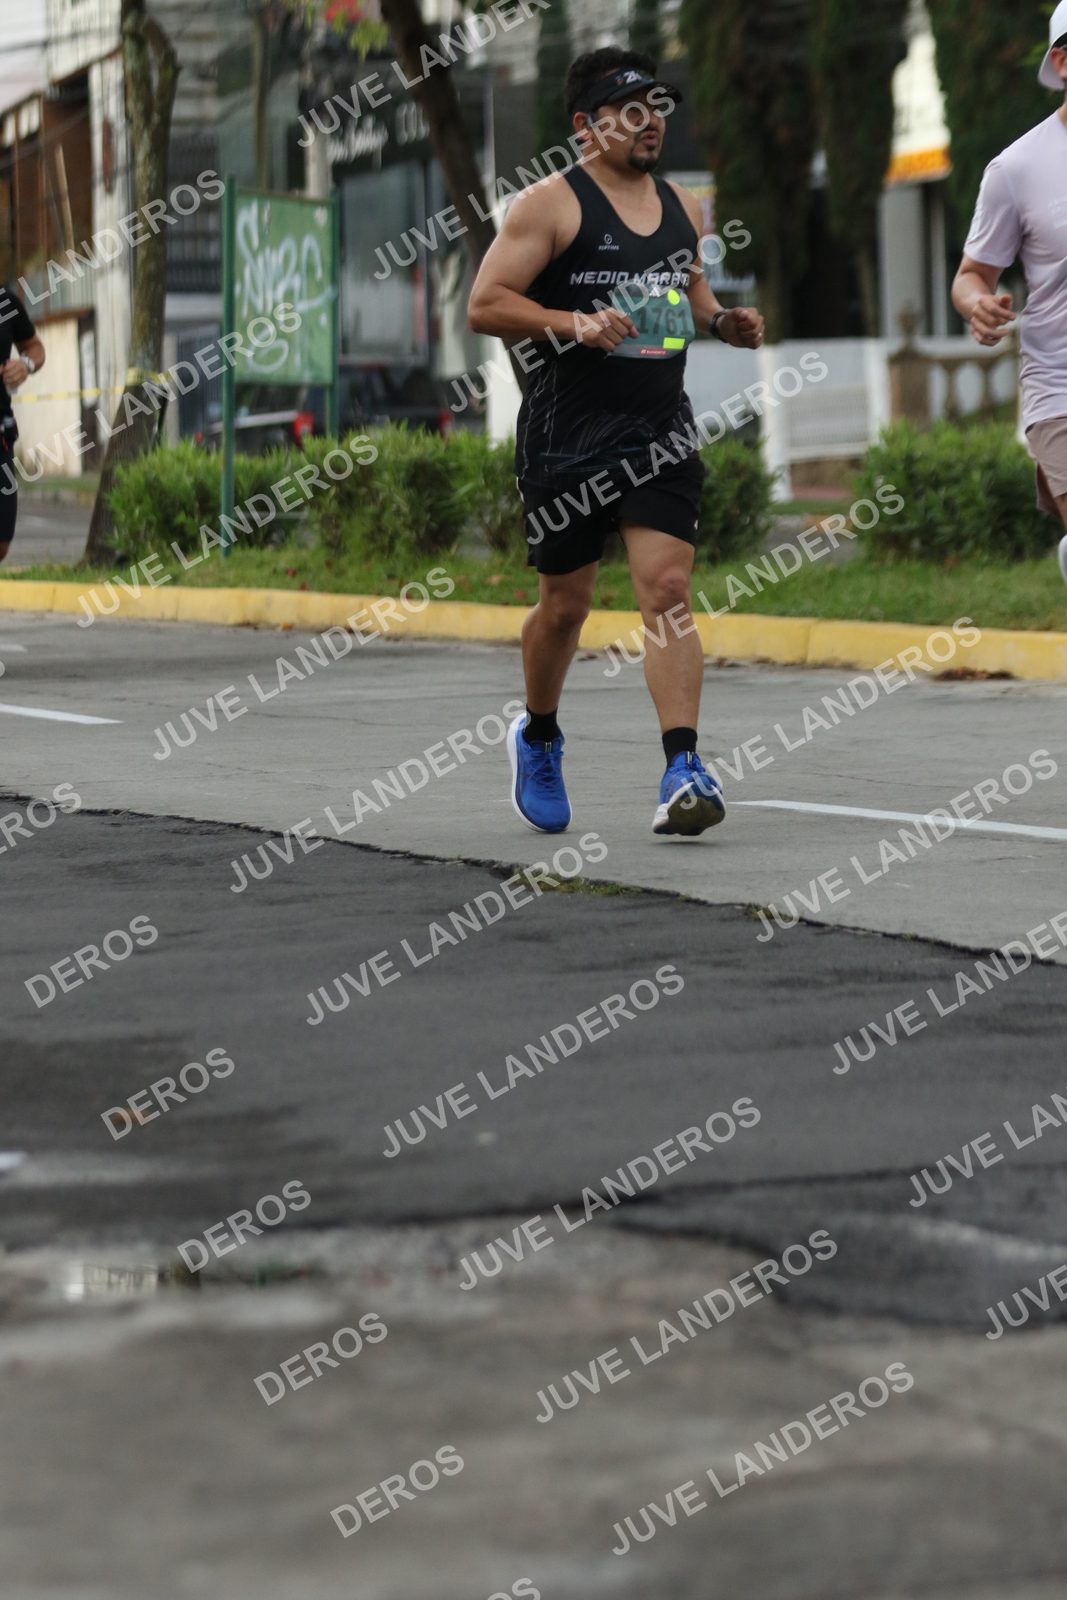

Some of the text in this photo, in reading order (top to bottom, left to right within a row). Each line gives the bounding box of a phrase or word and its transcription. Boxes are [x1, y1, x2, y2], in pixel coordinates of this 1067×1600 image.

[569, 270, 690, 287] MEDIO MARAT
[637, 306, 692, 336] 1761
